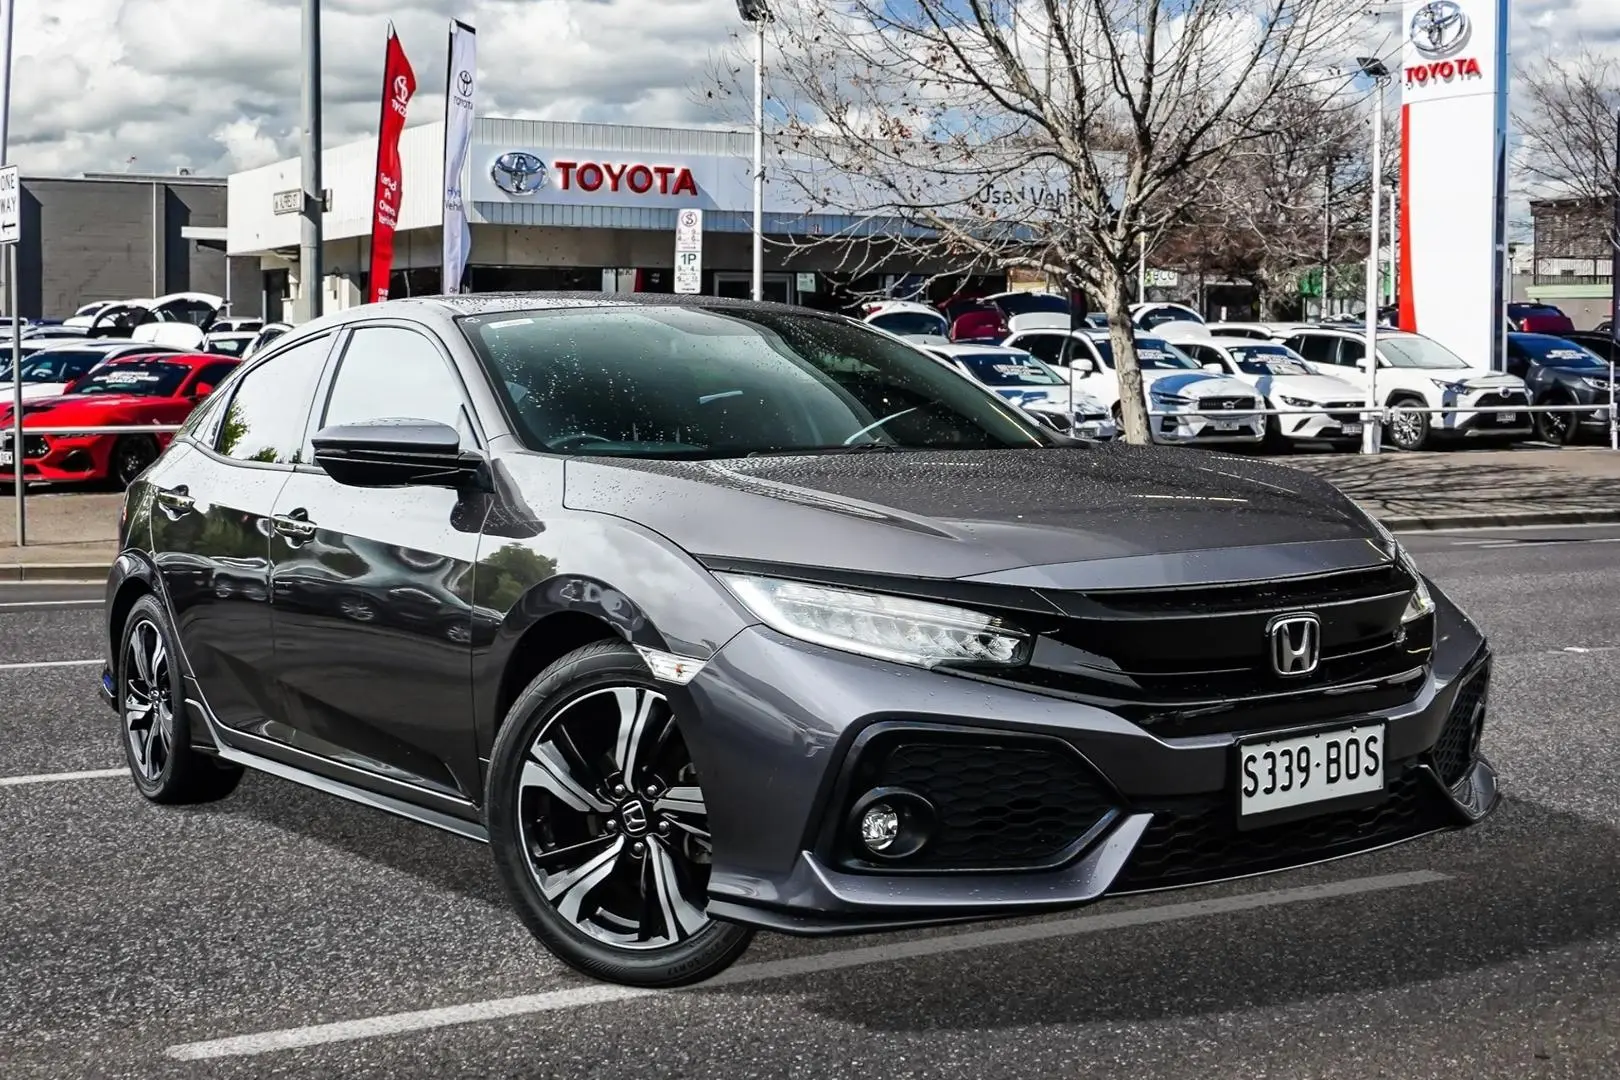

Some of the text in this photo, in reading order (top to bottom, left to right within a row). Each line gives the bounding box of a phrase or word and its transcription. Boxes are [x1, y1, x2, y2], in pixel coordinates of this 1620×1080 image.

[1404, 58, 1480, 83] TOYOTA
[1, 173, 15, 191] ONE
[555, 161, 699, 196] TOYOTA
[0, 197, 16, 214] WAY
[680, 253, 697, 265] 1P
